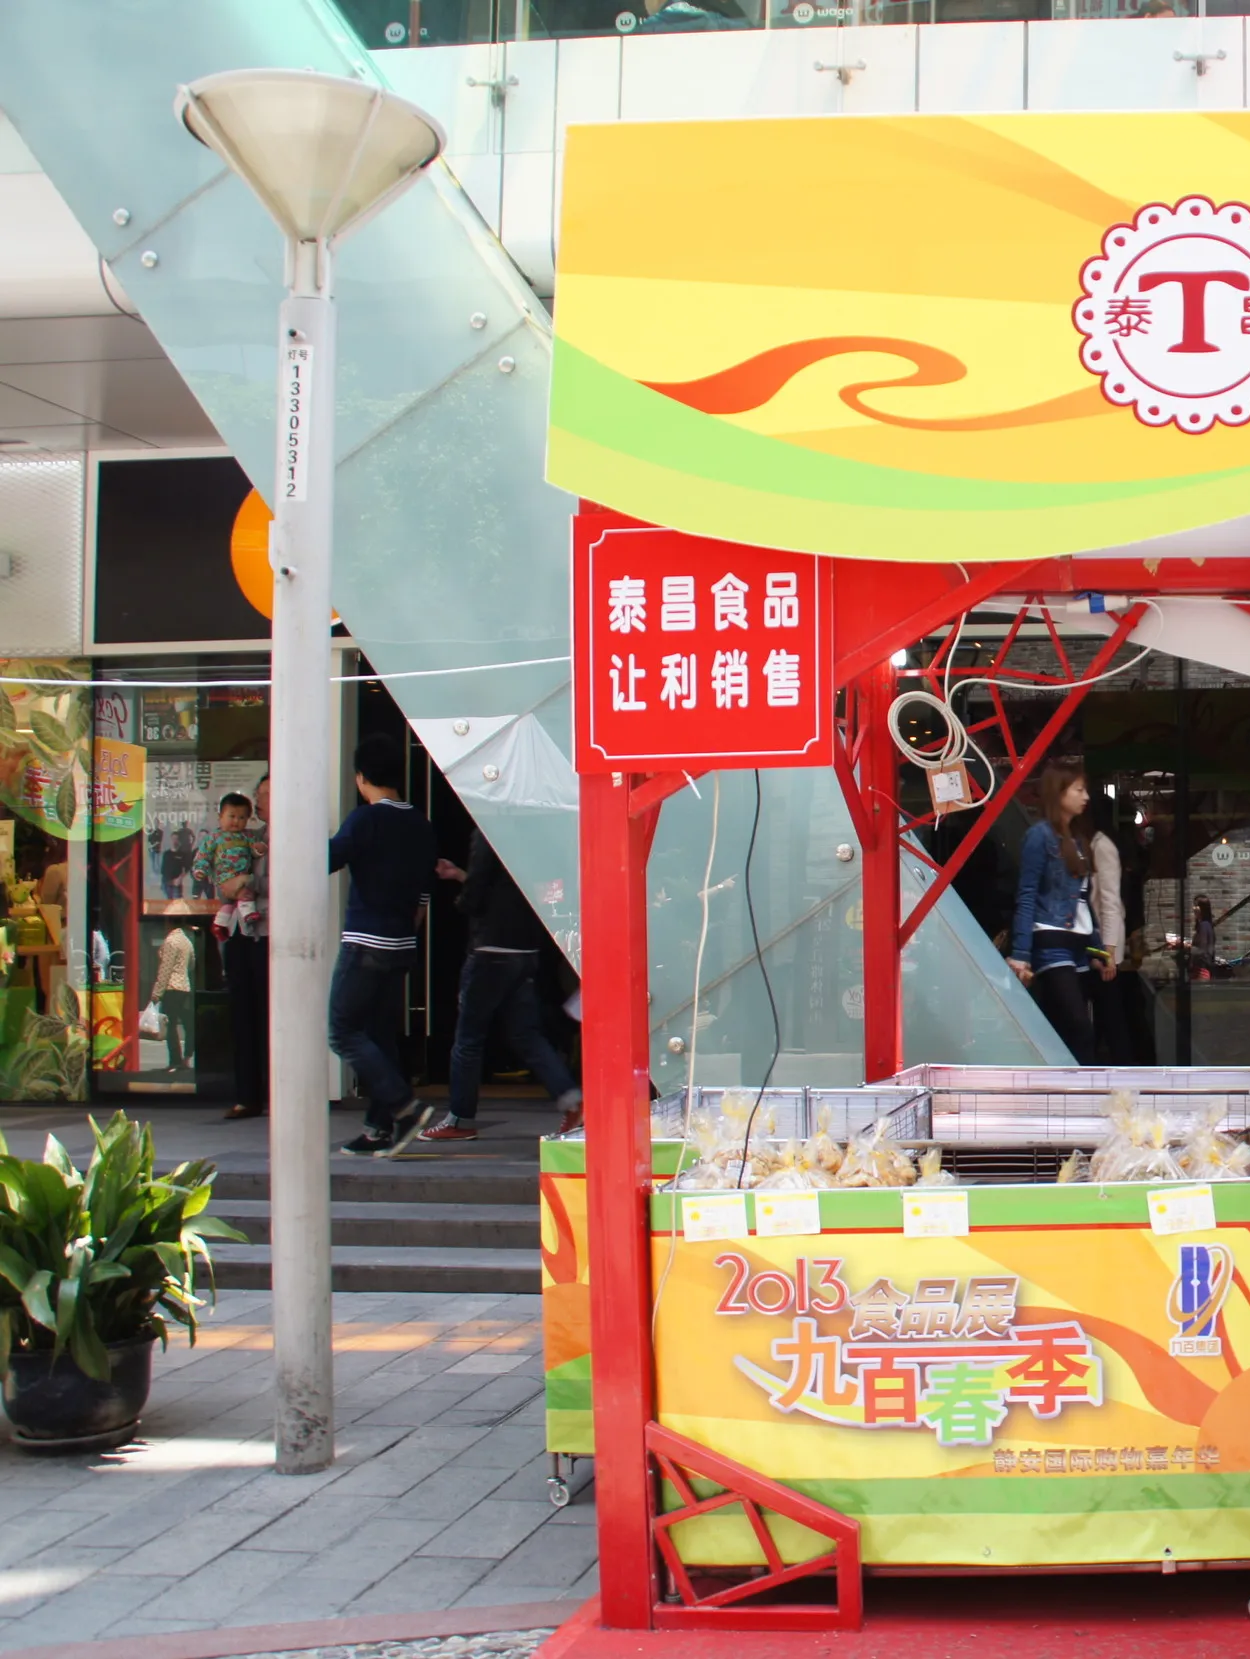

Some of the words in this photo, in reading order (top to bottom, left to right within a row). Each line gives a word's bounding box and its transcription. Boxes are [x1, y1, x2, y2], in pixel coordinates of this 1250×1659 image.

[817, 7, 854, 18] waga
[1104, 296, 1153, 337] 泰
[1138, 270, 1250, 353] T
[286, 365, 301, 498] 13305312
[608, 572, 799, 634] 泰昌食品
[608, 648, 801, 712] 让利销售
[714, 1254, 848, 1313] 2013
[850, 1278, 1018, 1338] 食品展
[773, 1320, 1092, 1443] 九百春季
[993, 1444, 1221, 1473] 静安国际购物嘉年华
